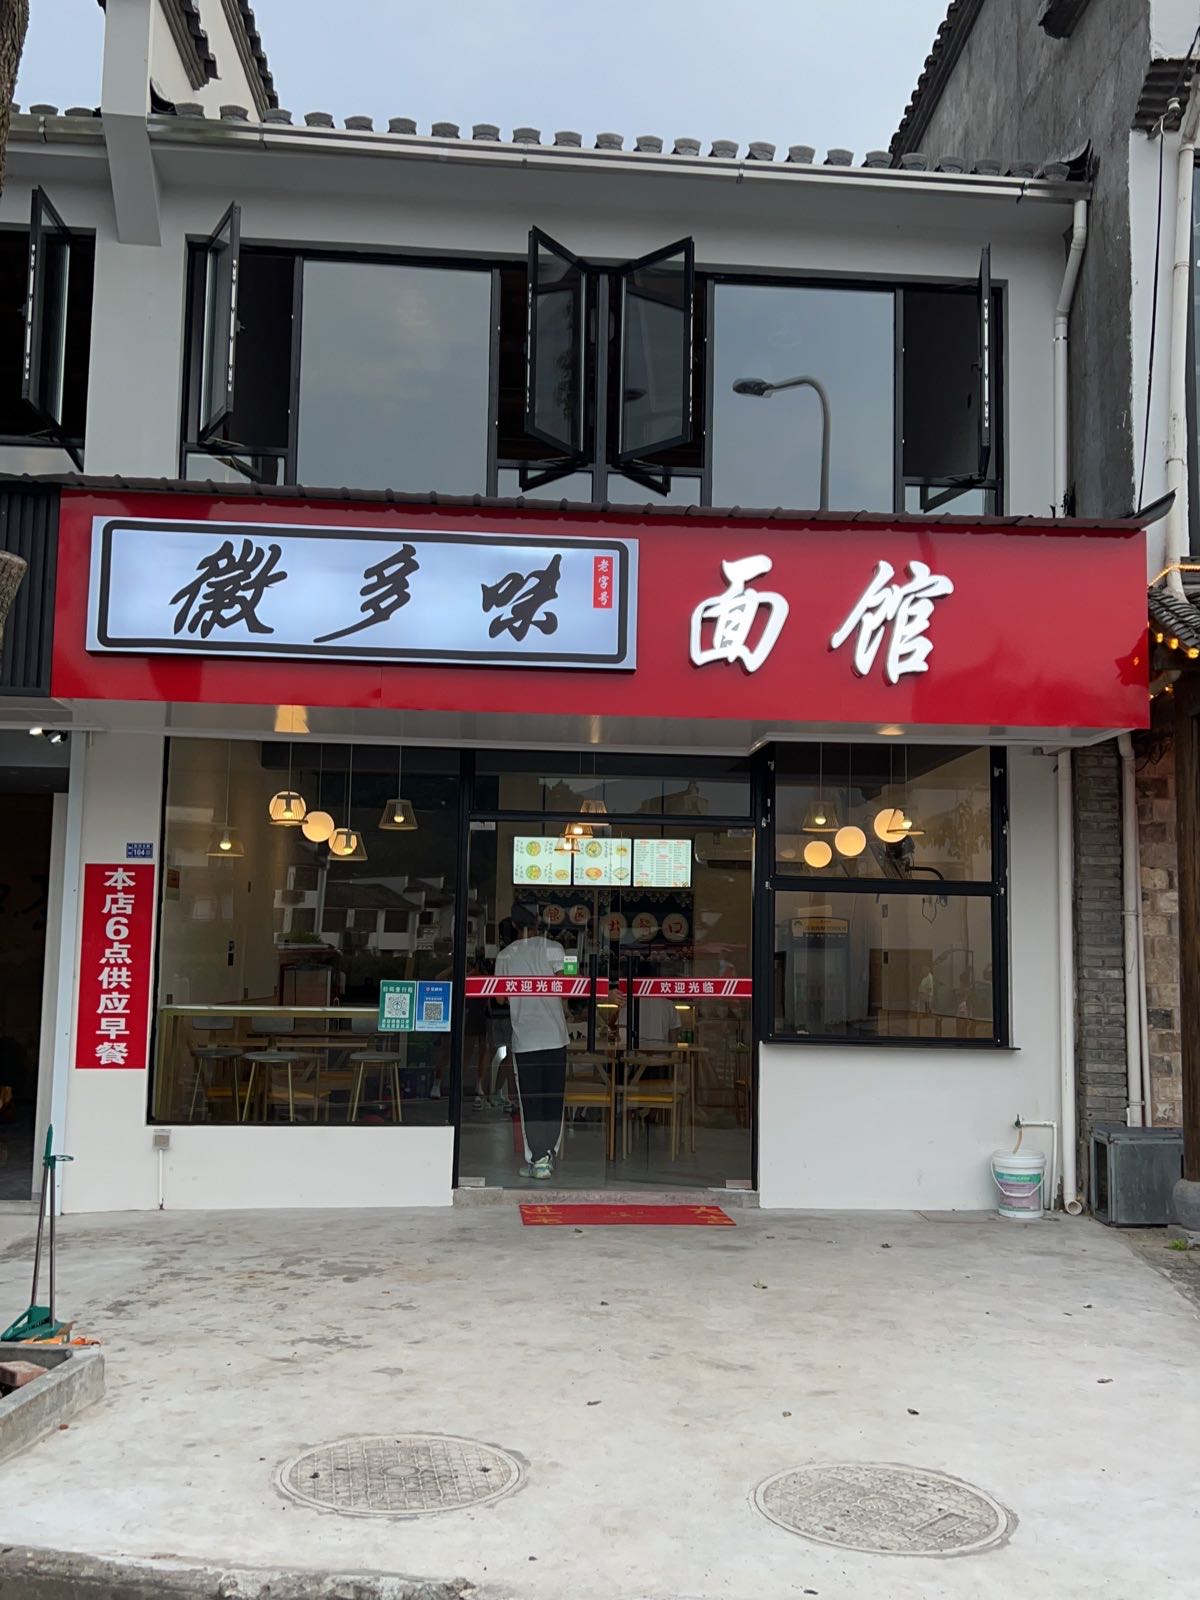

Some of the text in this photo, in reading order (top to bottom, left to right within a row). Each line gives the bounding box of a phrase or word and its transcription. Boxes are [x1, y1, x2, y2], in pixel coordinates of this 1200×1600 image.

[169, 537, 562, 643] 徽多味
[597, 559, 610, 606] 老字号
[690, 554, 954, 685] 面馆
[95, 867, 136, 1065] 本店6点供应早餐
[505, 980, 563, 992] 欢迎光临
[660, 981, 714, 993] 欢迎光临
